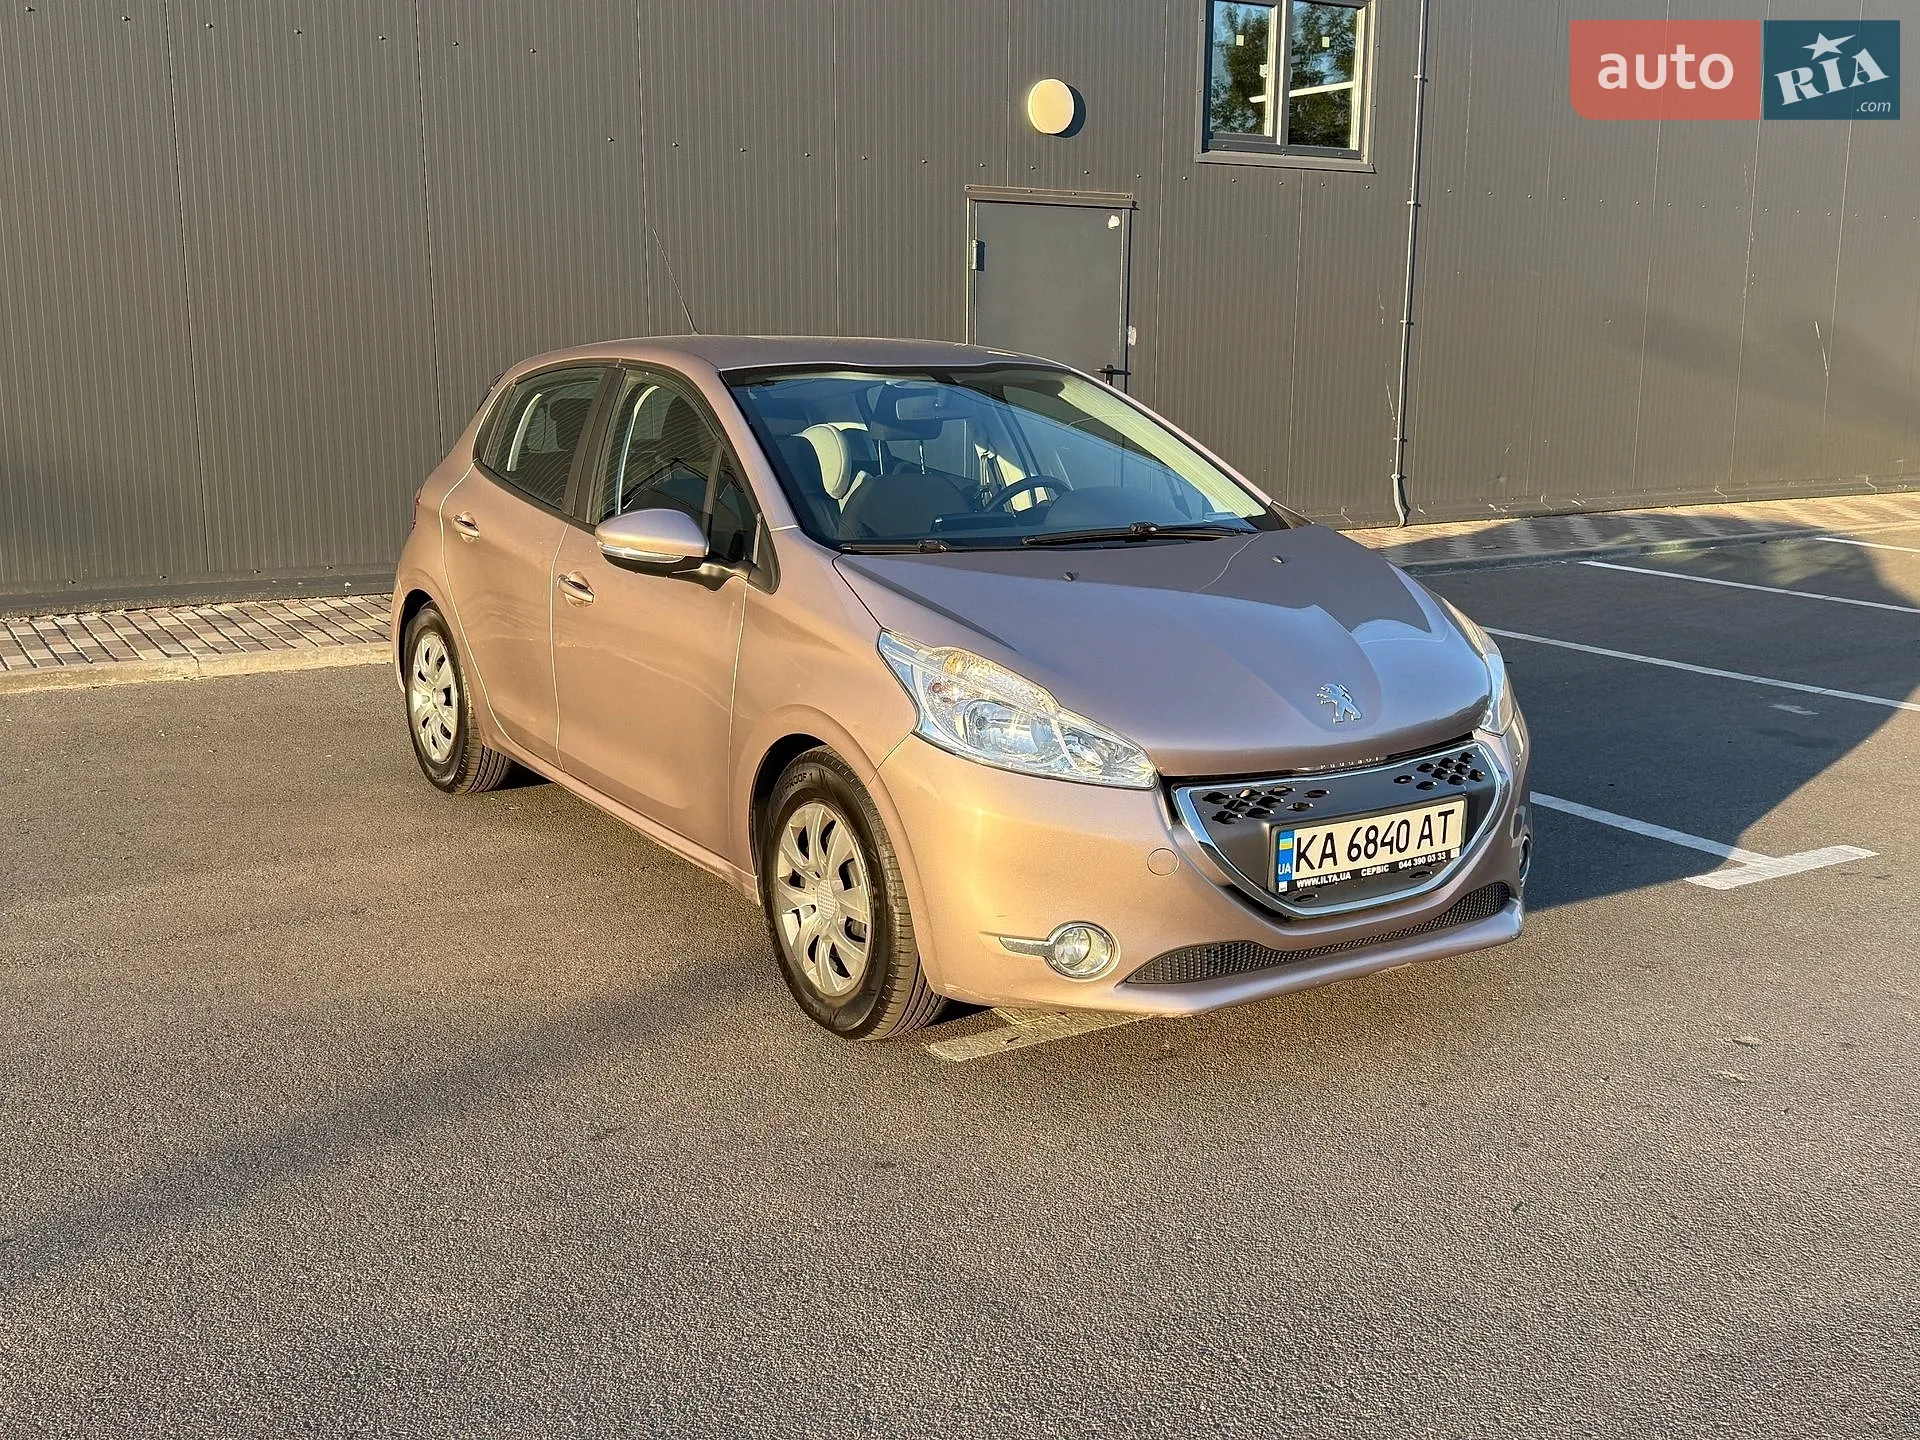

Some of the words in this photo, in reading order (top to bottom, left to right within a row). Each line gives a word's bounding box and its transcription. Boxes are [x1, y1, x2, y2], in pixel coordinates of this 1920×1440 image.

[1295, 832, 1338, 873] KA
[1347, 819, 1411, 862] 6840
[1417, 809, 1455, 850] AT
[1277, 863, 1292, 875] UA
[1296, 872, 1351, 888] WWW.ILTA.UA
[1398, 861, 1412, 870] 044
[1413, 858, 1426, 867] 390
[1427, 854, 1436, 863] 03
[1437, 852, 1446, 861] 33
